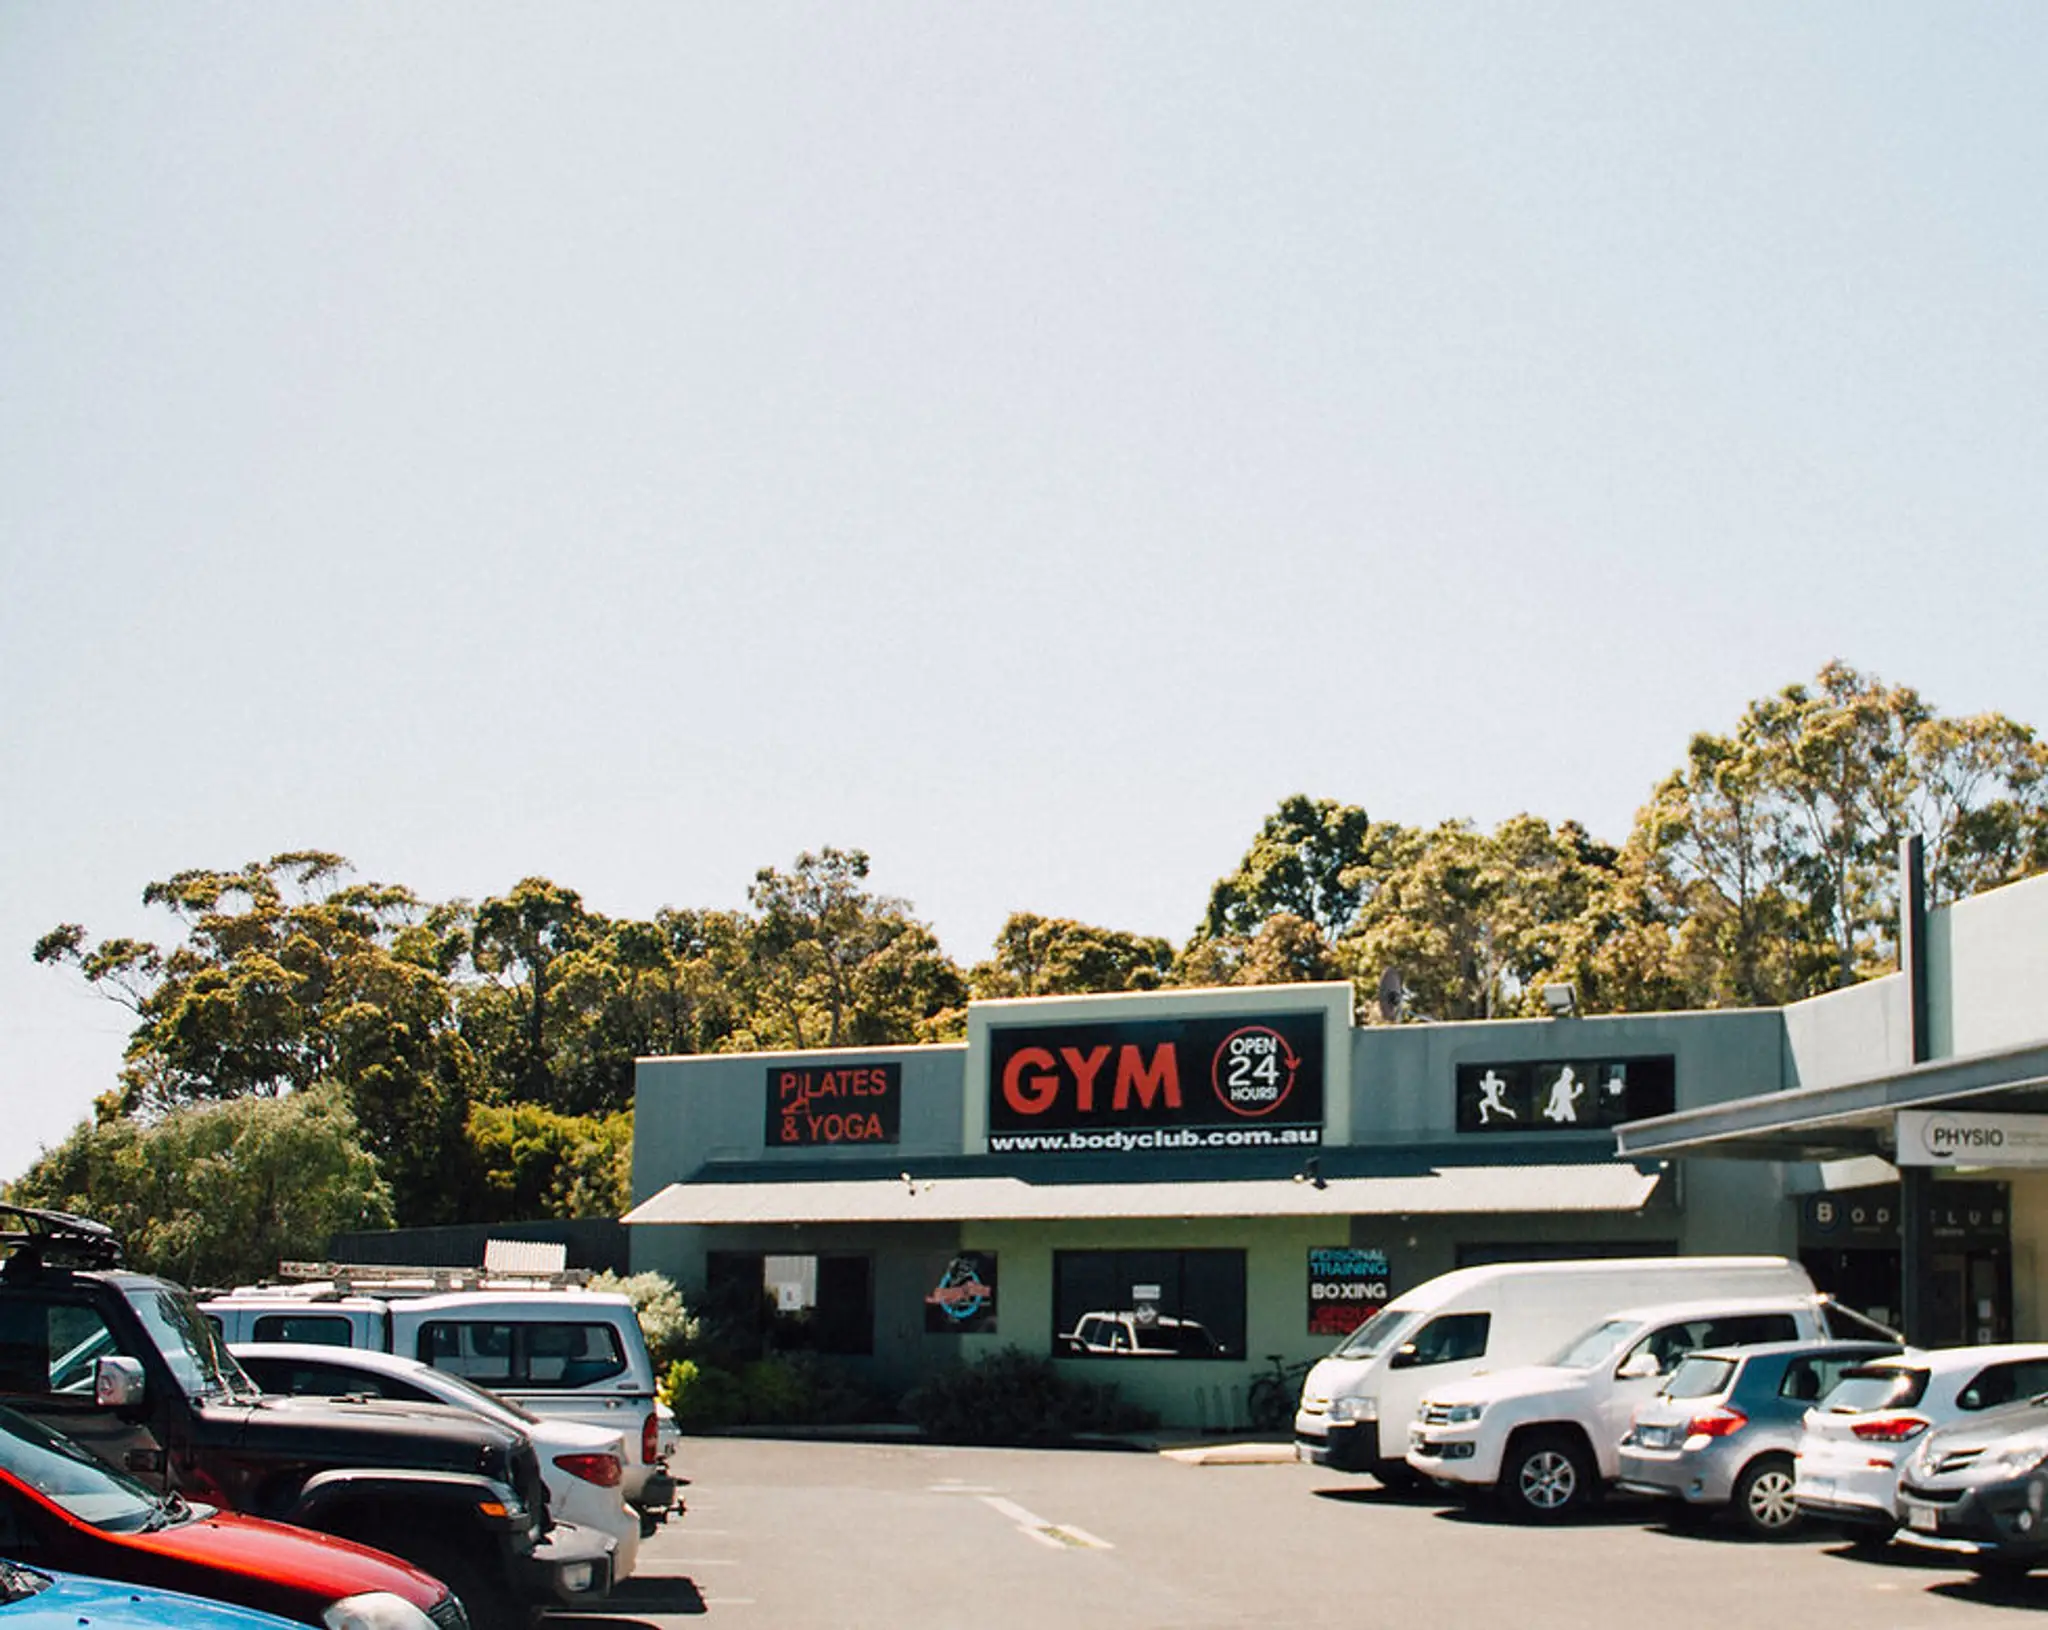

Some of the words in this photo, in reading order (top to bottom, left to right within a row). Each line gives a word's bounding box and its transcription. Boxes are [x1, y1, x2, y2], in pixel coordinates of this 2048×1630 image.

[1230, 1036, 1277, 1055] OPEN
[1003, 1042, 1182, 1115] GYM
[1228, 1055, 1280, 1086] 24
[780, 1069, 887, 1099] PILATES
[781, 1115, 800, 1140] &
[807, 1112, 884, 1141] YOGA
[1933, 1127, 2004, 1147] PHYSIO
[991, 1129, 1319, 1151] www.bodyclub.com.au
[1816, 1202, 1890, 1223] BOD
[1311, 1261, 1388, 1276] TRAINING
[1311, 1282, 1387, 1299] BOXING
